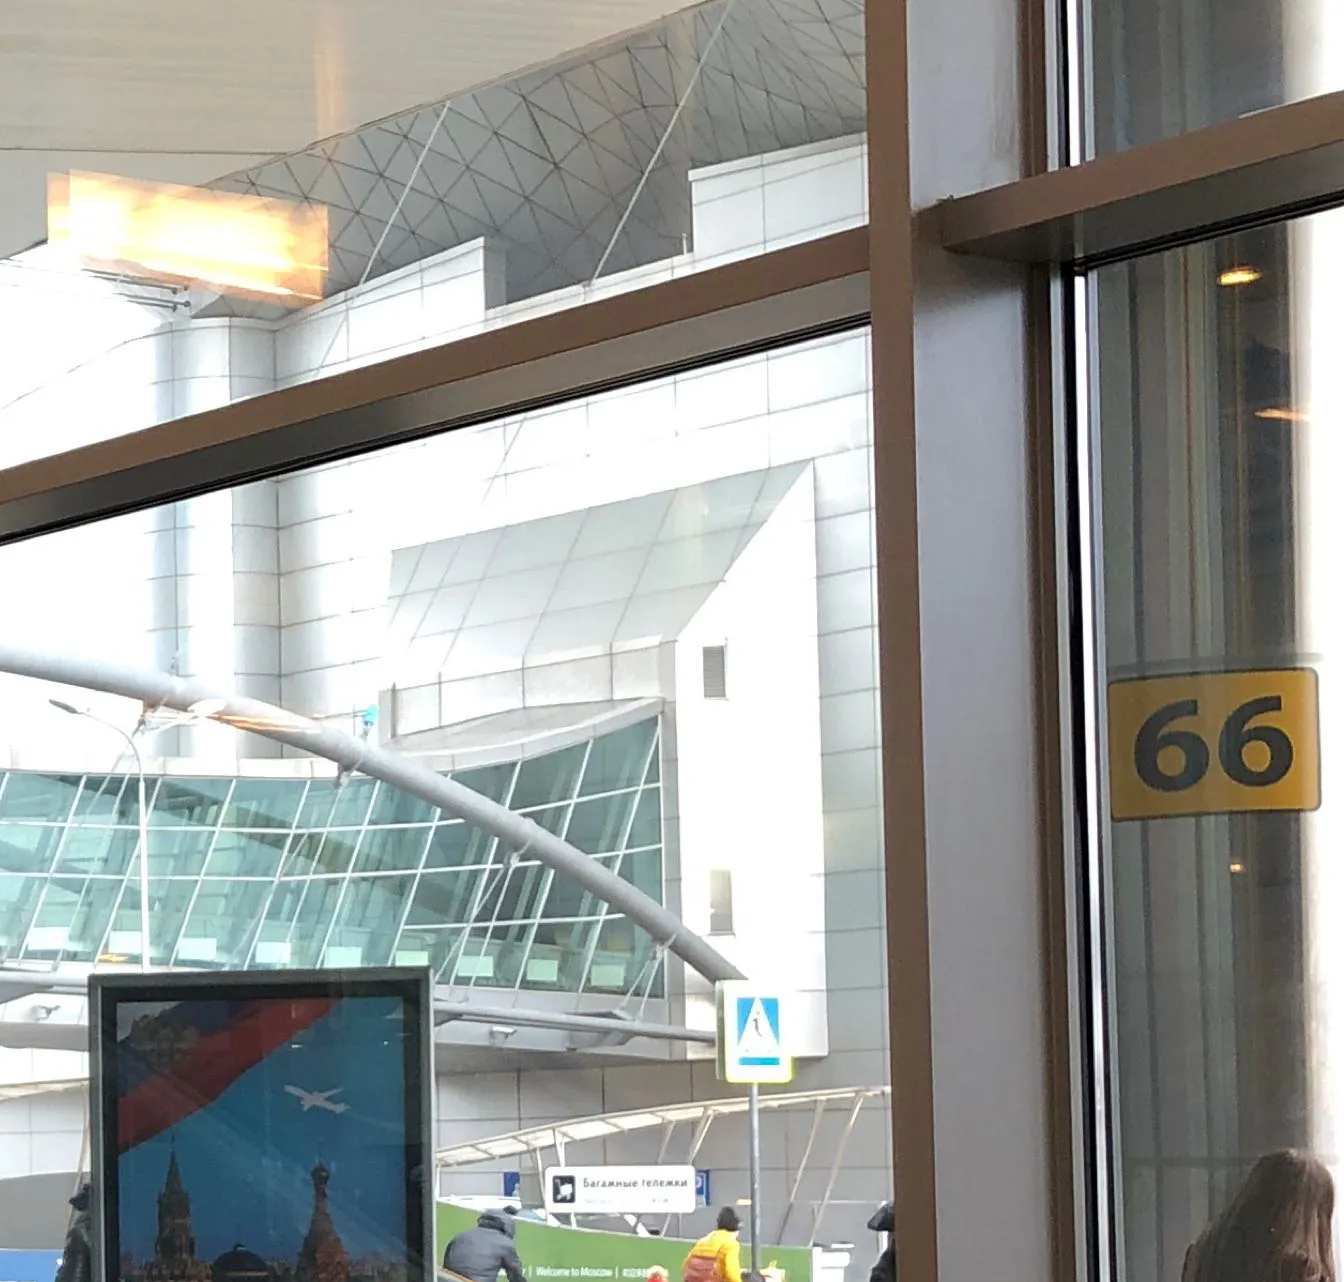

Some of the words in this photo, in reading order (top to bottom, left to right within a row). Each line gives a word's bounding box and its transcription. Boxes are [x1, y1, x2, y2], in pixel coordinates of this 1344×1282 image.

[1134, 695, 1294, 793] 66
[583, 1177, 638, 1189] Багажные
[642, 1177, 688, 1188] тележки
[535, 1265, 570, 1277] Welcome
[571, 1266, 580, 1277] to
[581, 1265, 613, 1277] Moscow
